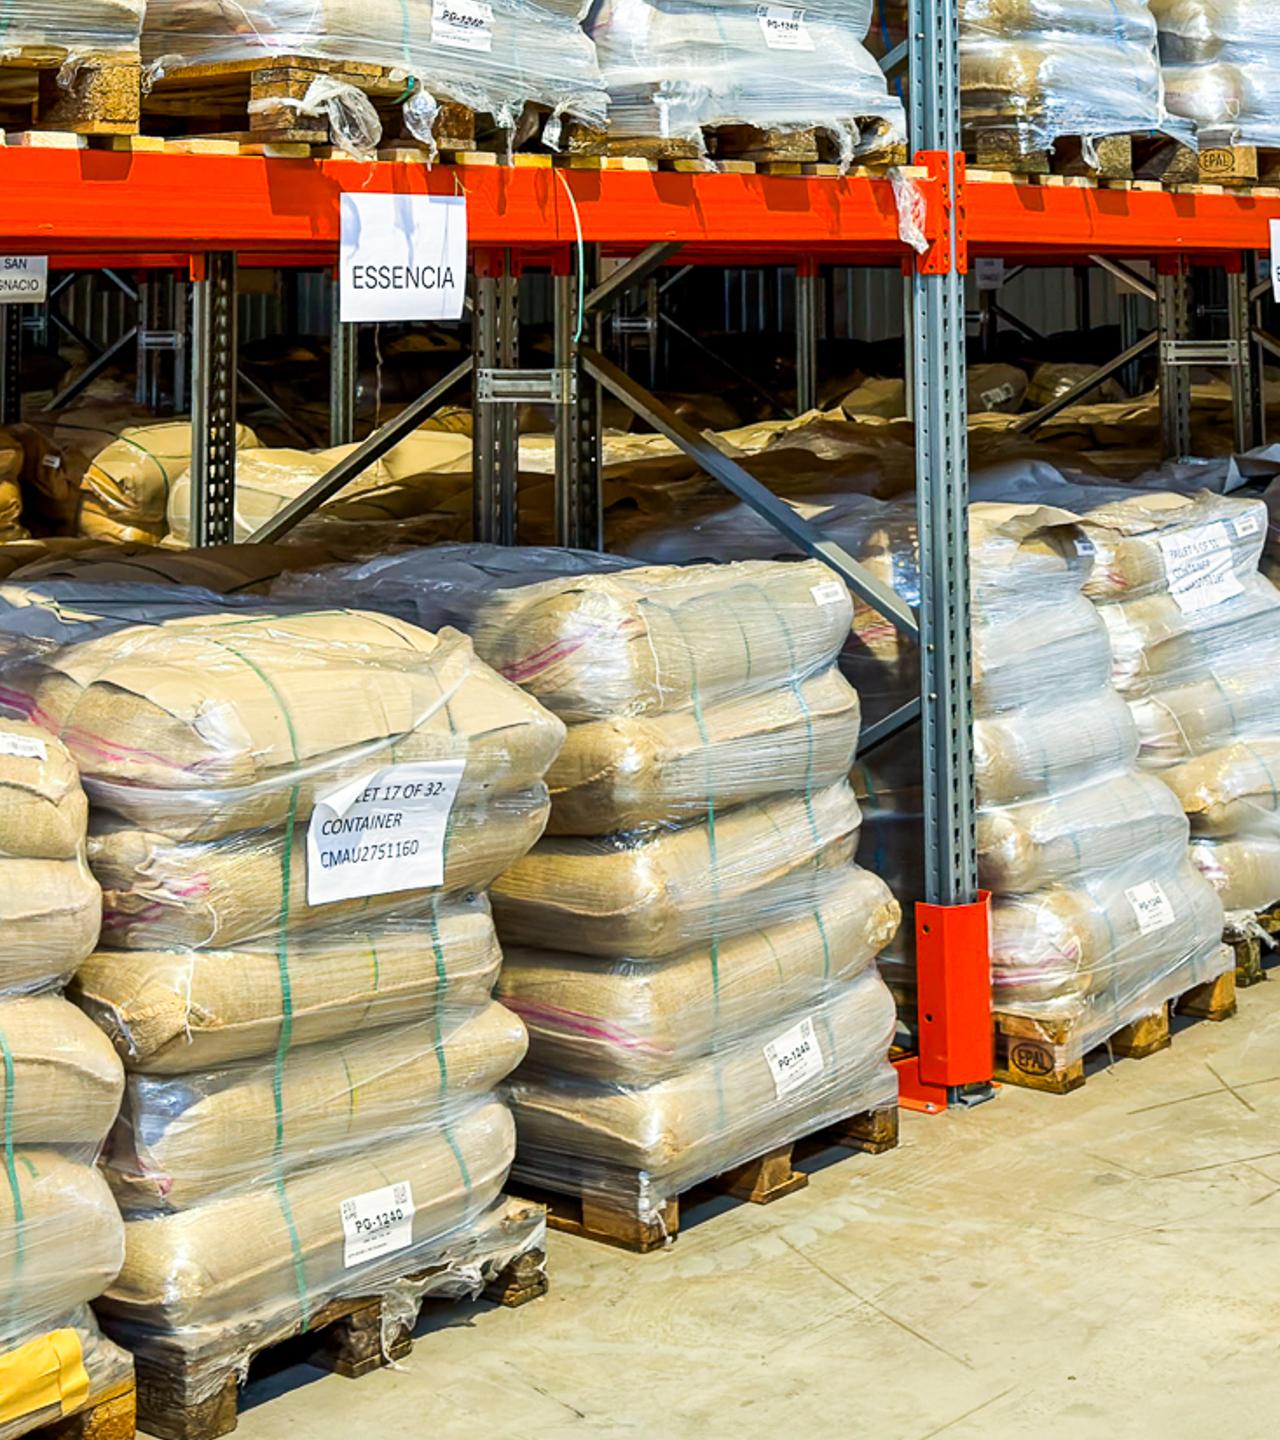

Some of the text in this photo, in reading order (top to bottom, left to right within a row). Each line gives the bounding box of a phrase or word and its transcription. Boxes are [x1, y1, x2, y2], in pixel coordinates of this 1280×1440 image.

[1204, 154, 1229, 168] EPAL
[4, 258, 27, 269] SAN
[352, 265, 455, 289] ESSENCIA
[383, 785, 401, 801] 17
[403, 783, 423, 799] OF
[322, 813, 402, 836] CONTAINER
[321, 839, 419, 869] CMAU2751160
[1022, 1048, 1046, 1068] EPAL
[355, 1208, 404, 1233] PG-1240
